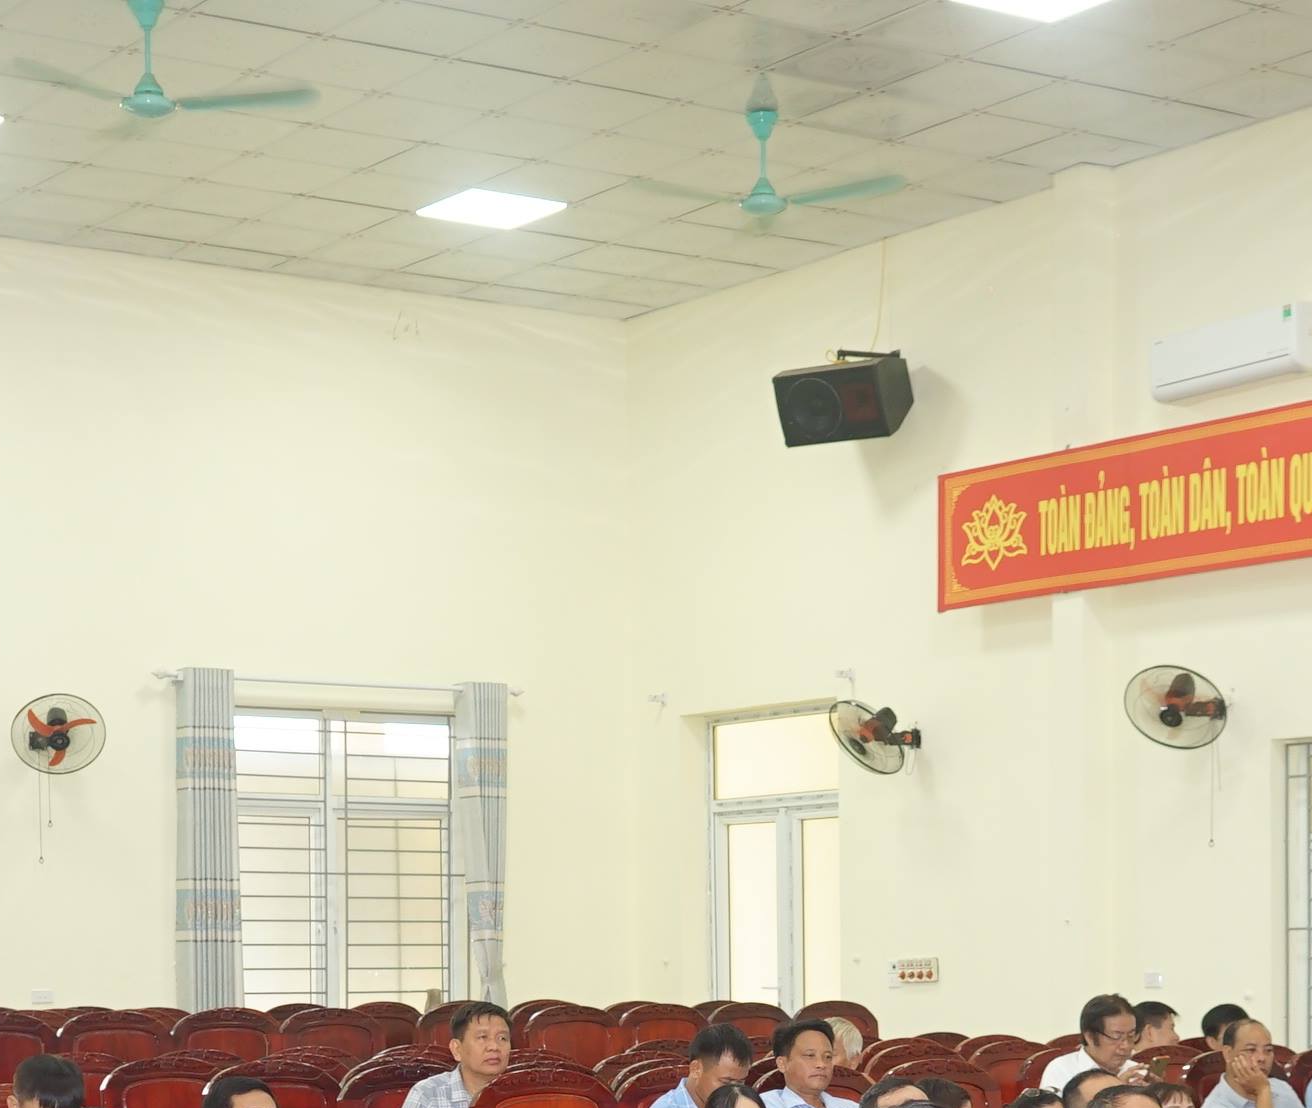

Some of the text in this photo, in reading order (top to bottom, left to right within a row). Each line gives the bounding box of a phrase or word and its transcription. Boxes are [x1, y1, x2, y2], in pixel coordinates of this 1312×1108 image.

[1038, 484, 1081, 556] TOÀN
[1084, 470, 1135, 550] ĐẢNG,
[1138, 463, 1185, 541] TOÀN
[1188, 456, 1232, 534] DÂN,
[1235, 456, 1287, 525] TOÀN
